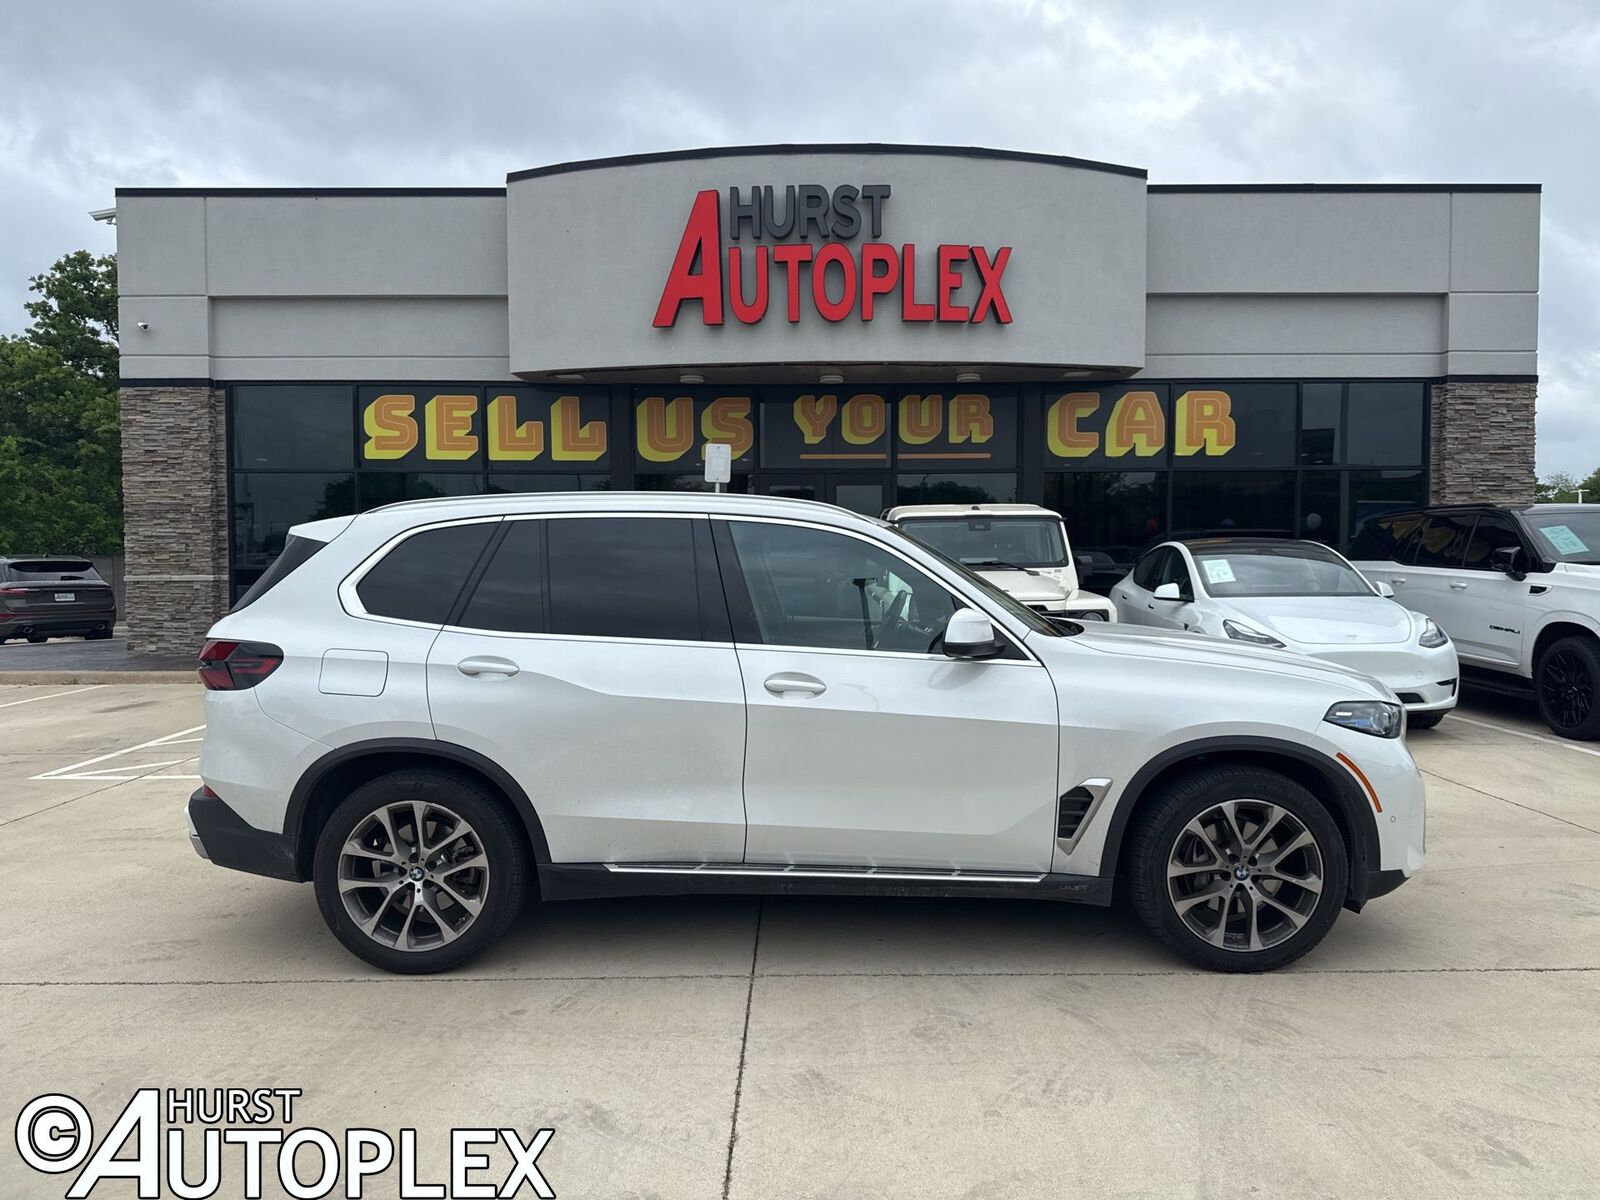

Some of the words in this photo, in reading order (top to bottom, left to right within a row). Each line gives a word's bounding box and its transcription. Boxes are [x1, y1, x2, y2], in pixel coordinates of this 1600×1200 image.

[729, 184, 891, 240] HURST
[652, 189, 1014, 328] AUTOPLEX
[363, 394, 607, 461] SELL
[636, 396, 754, 463] US
[793, 394, 994, 445] YOUR
[1047, 391, 1236, 457] CAR
